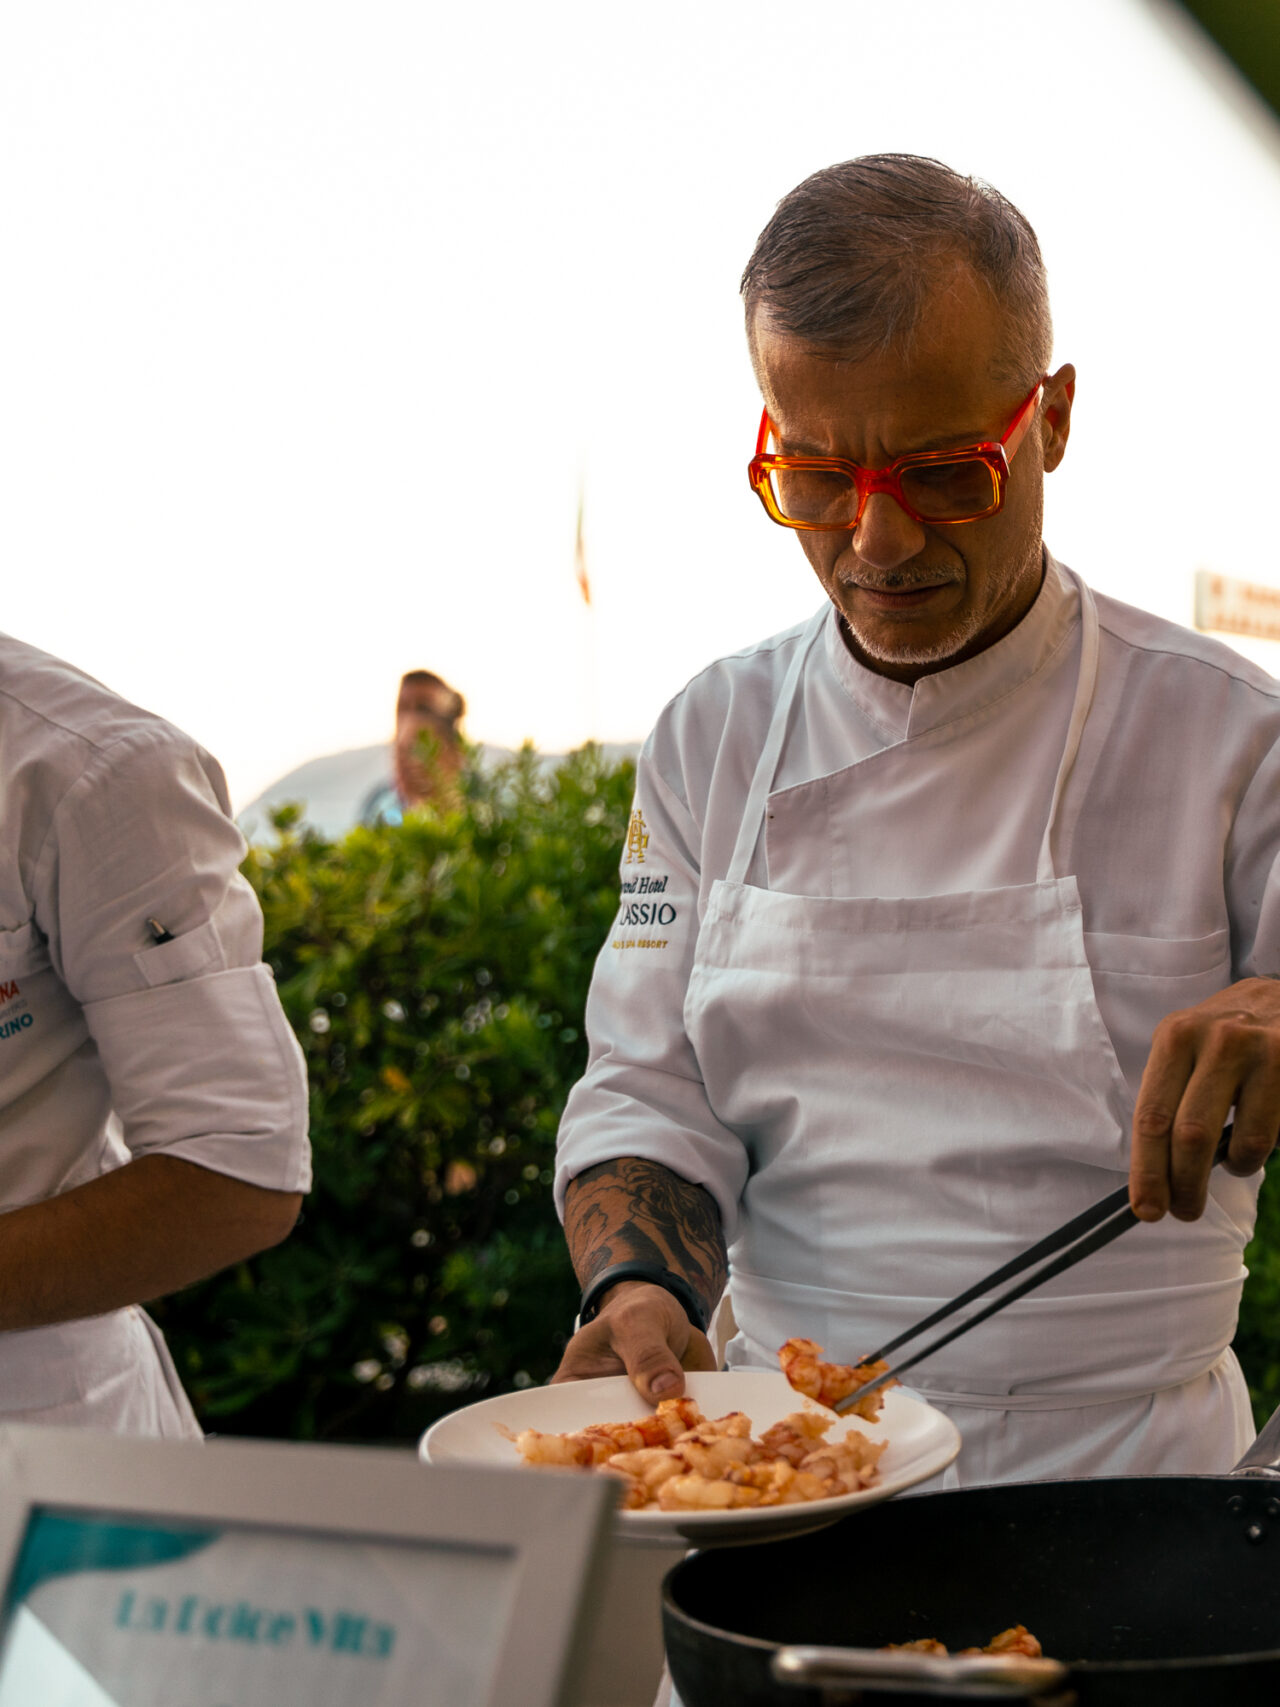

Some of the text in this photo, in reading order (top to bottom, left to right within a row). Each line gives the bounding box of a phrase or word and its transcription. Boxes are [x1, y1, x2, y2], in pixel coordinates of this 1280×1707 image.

[638, 875, 668, 894] Hotel
[620, 902, 677, 925] LASSIO
[0, 979, 20, 1004] NA
[0, 1012, 33, 1039] RINO
[304, 1606, 397, 1662] Vita
